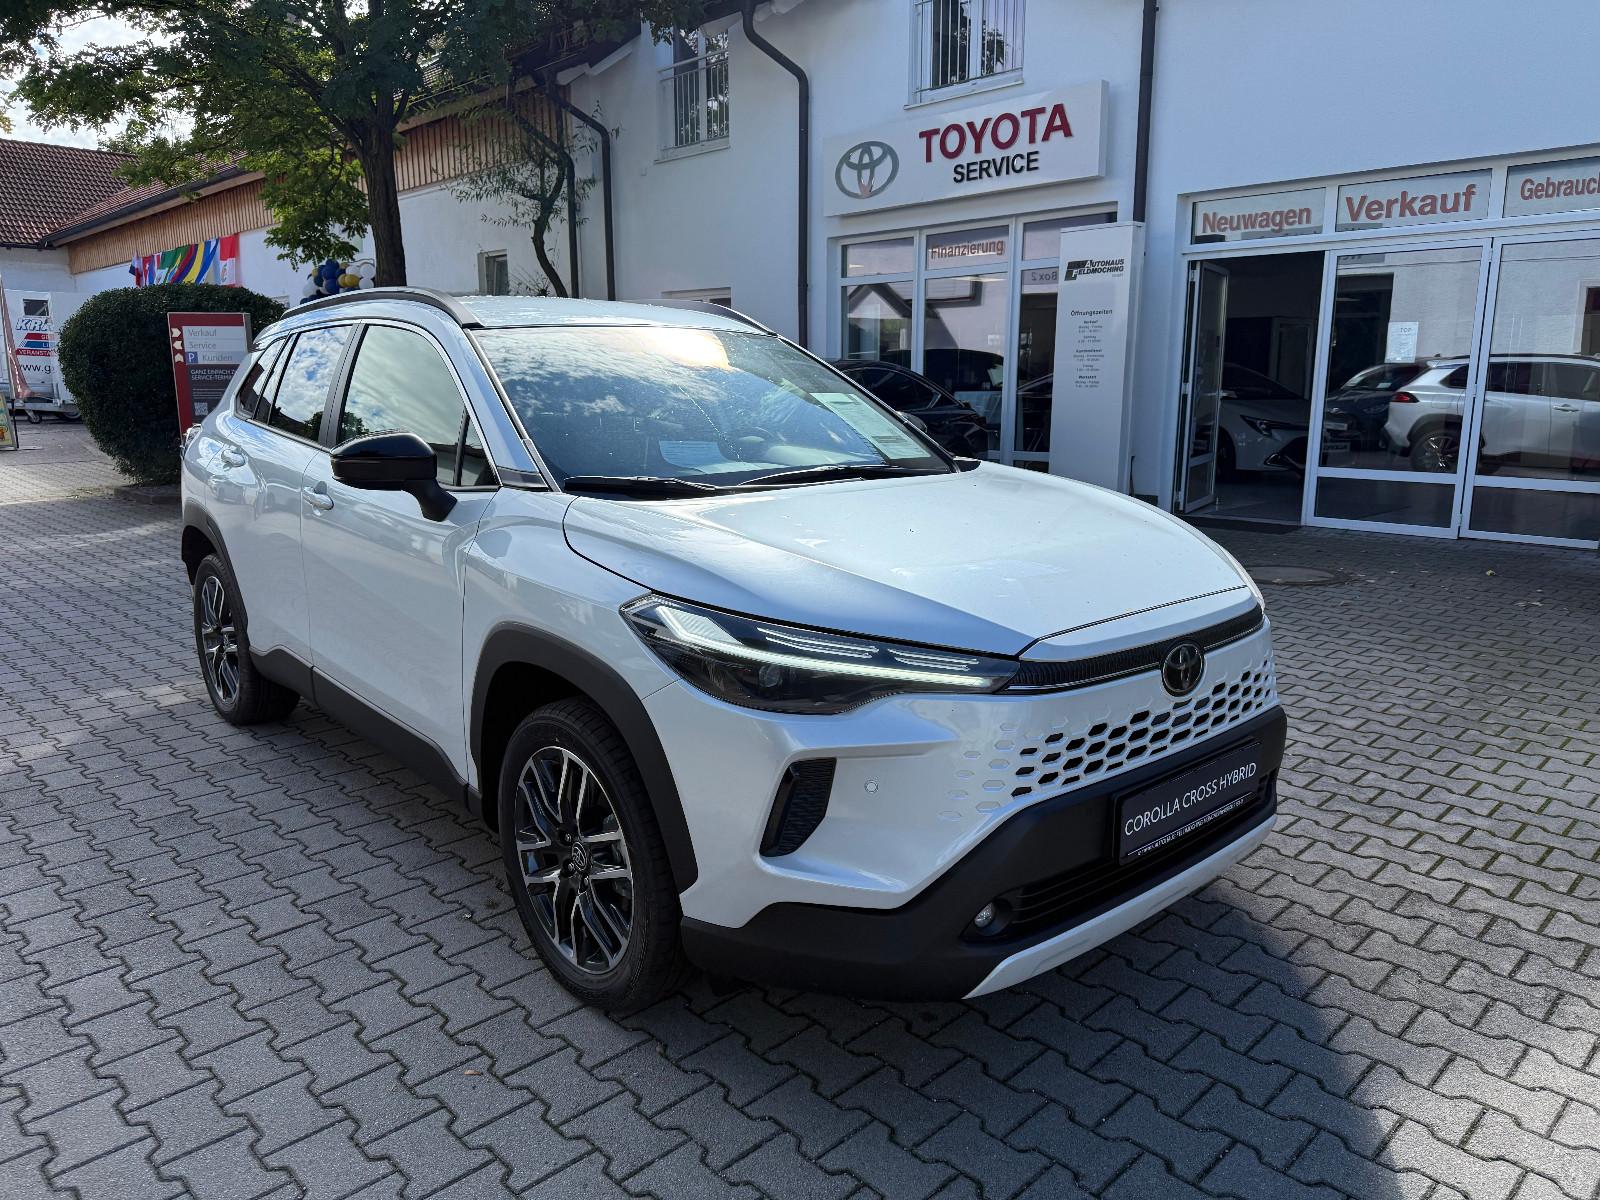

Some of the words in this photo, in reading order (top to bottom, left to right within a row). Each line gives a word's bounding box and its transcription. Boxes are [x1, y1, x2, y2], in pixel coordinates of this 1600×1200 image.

[919, 103, 1073, 163] TOYOTA
[953, 151, 1039, 183] SERVICE
[1520, 174, 1600, 201] Gebrauc
[1345, 184, 1476, 222] Verkauf
[1202, 206, 1311, 234] Neuwagen
[930, 240, 1004, 260] Finanzierung
[1072, 265, 1124, 278] FELDMOCHING
[1085, 258, 1124, 269] AUTOHAUS
[188, 329, 217, 337] Verkauf
[189, 341, 217, 350] Service
[188, 352, 195, 363] P
[202, 353, 233, 361] Kunden
[1125, 797, 1180, 836] COROLLA
[1182, 779, 1218, 808] CROSS
[1219, 762, 1257, 791] HYBRID
